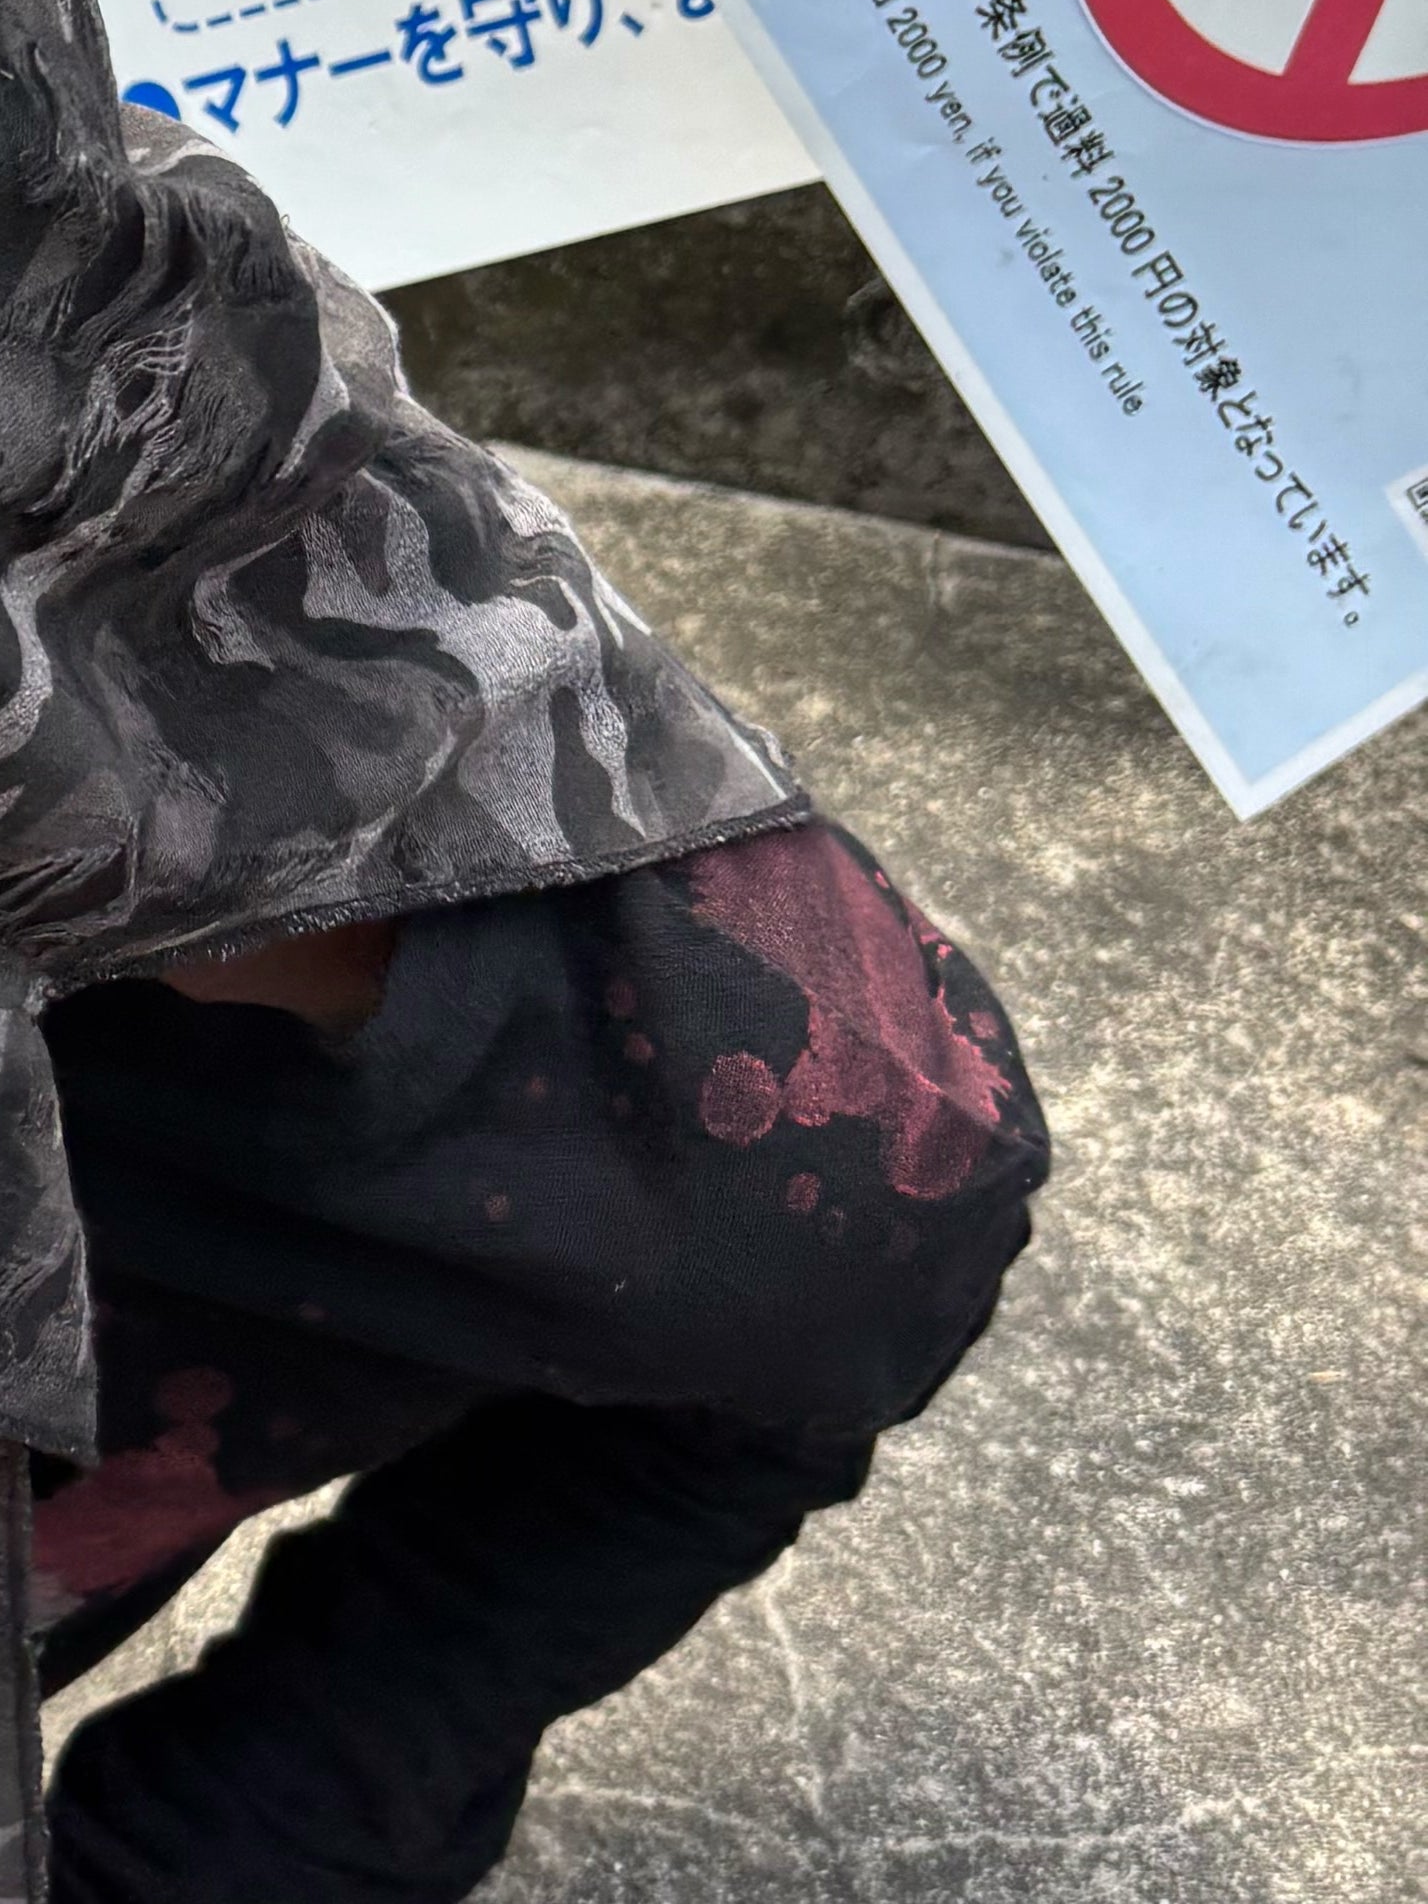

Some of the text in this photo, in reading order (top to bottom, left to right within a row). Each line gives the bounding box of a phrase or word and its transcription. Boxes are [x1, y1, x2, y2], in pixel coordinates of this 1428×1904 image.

[887, 8, 947, 79] 2000
[925, 81, 973, 144] yen,
[966, 136, 1002, 165] if
[977, 165, 1024, 218] you
[1088, 176, 1155, 256] 2000
[1016, 218, 1076, 308] violate
[1071, 305, 1114, 362] this
[1101, 362, 1144, 416] rule
